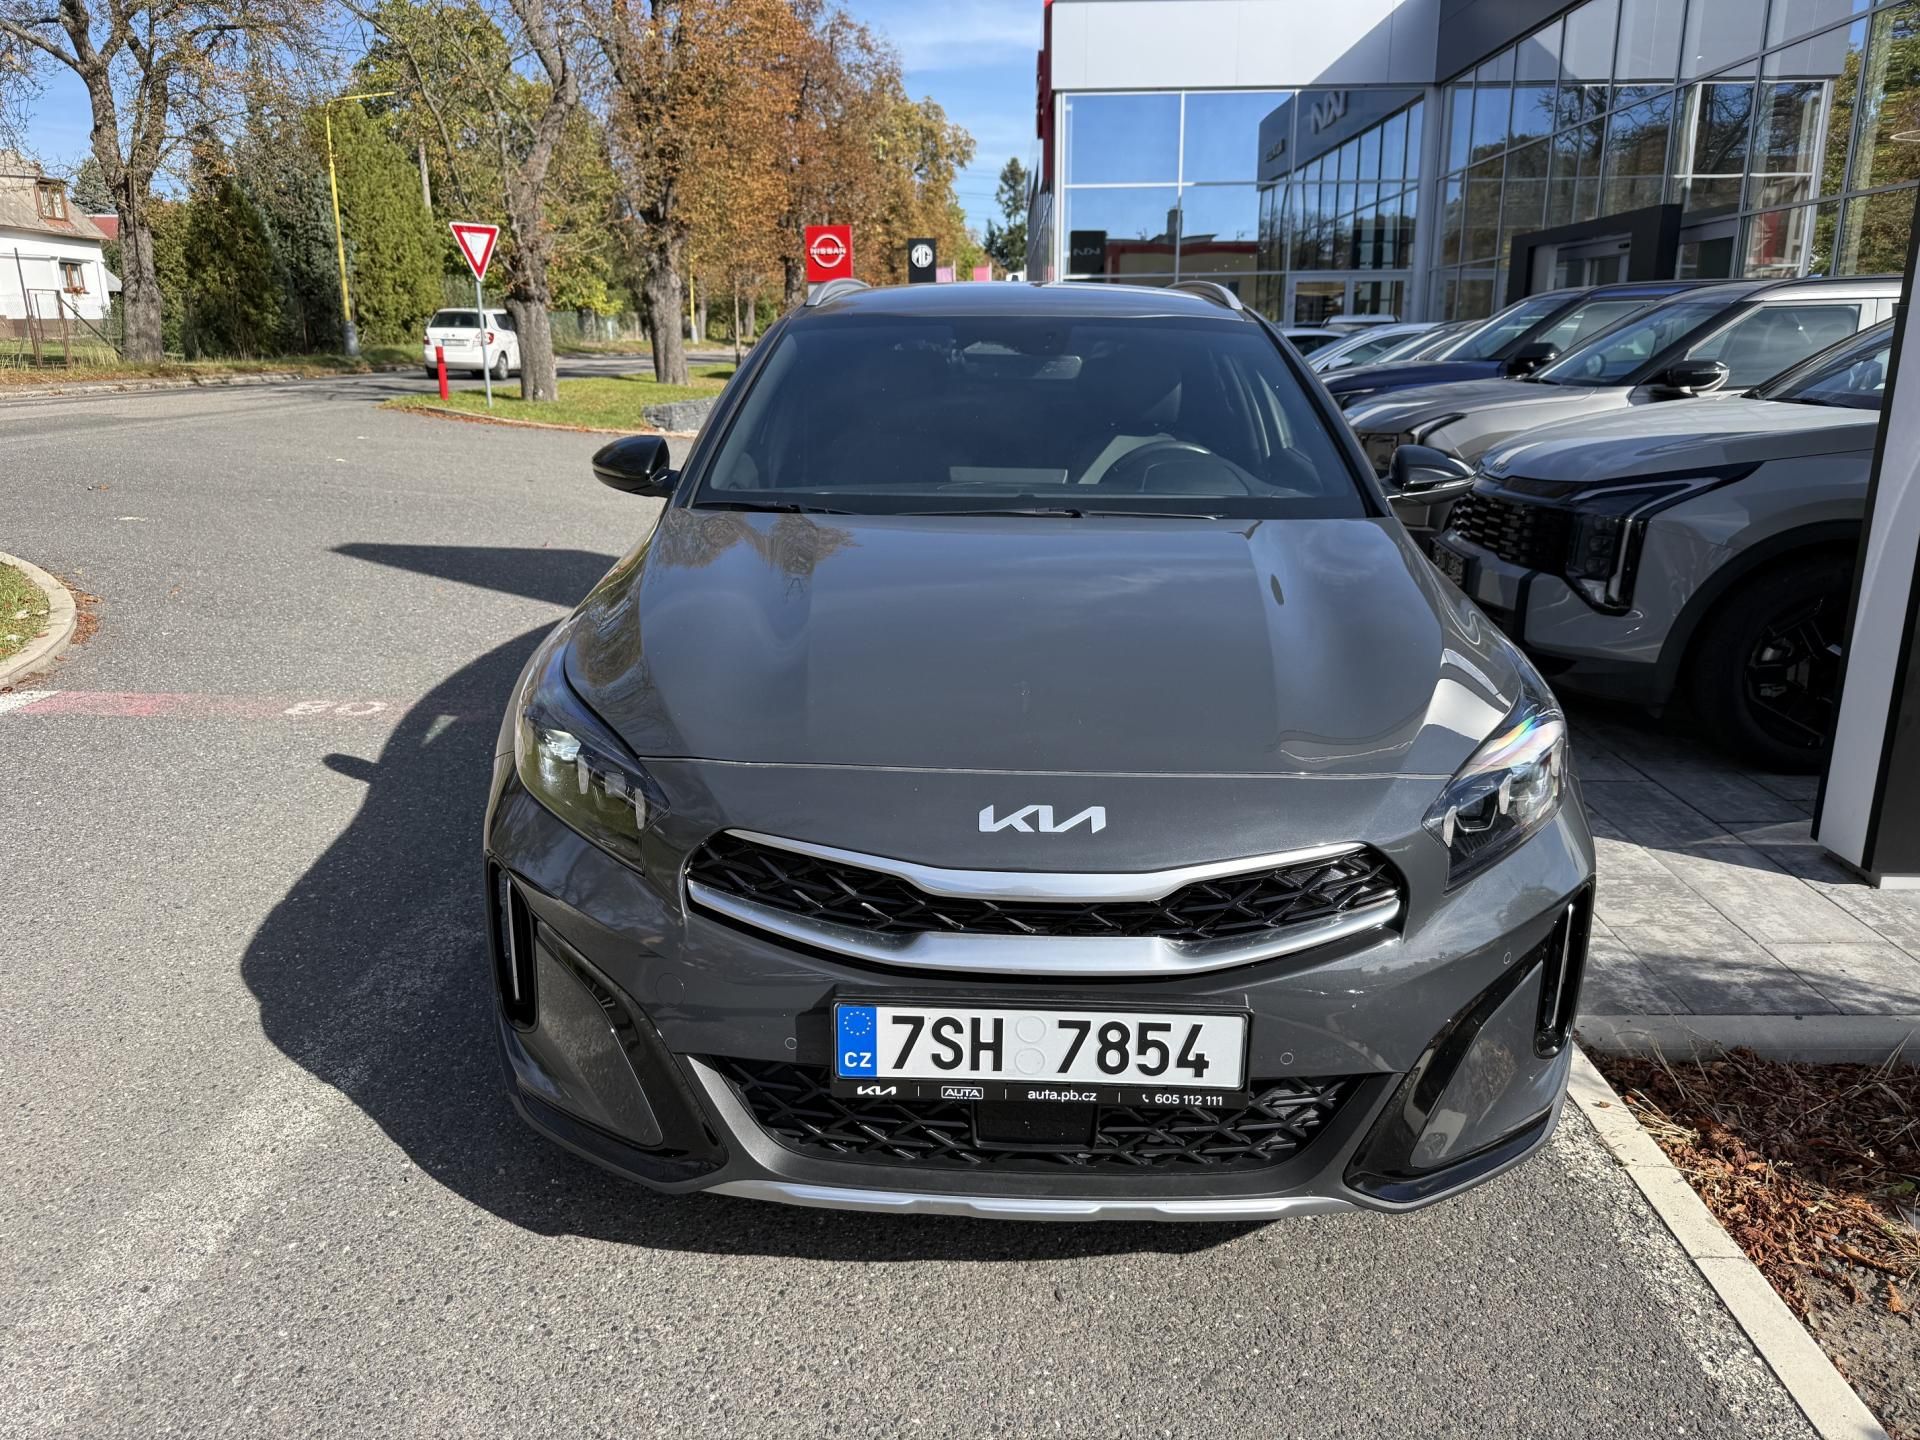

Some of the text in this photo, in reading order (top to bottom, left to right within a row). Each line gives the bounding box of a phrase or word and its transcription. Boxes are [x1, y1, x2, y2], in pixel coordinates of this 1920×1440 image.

[809, 247, 847, 256] NISSAN
[912, 245, 933, 267] MG
[978, 804, 1107, 834] KIA
[891, 1015, 1210, 1078] 7SH 7854
[844, 1051, 872, 1068] CZ
[856, 1086, 1223, 1106] KIA AUTA auta.pb.cz 605 112 111
